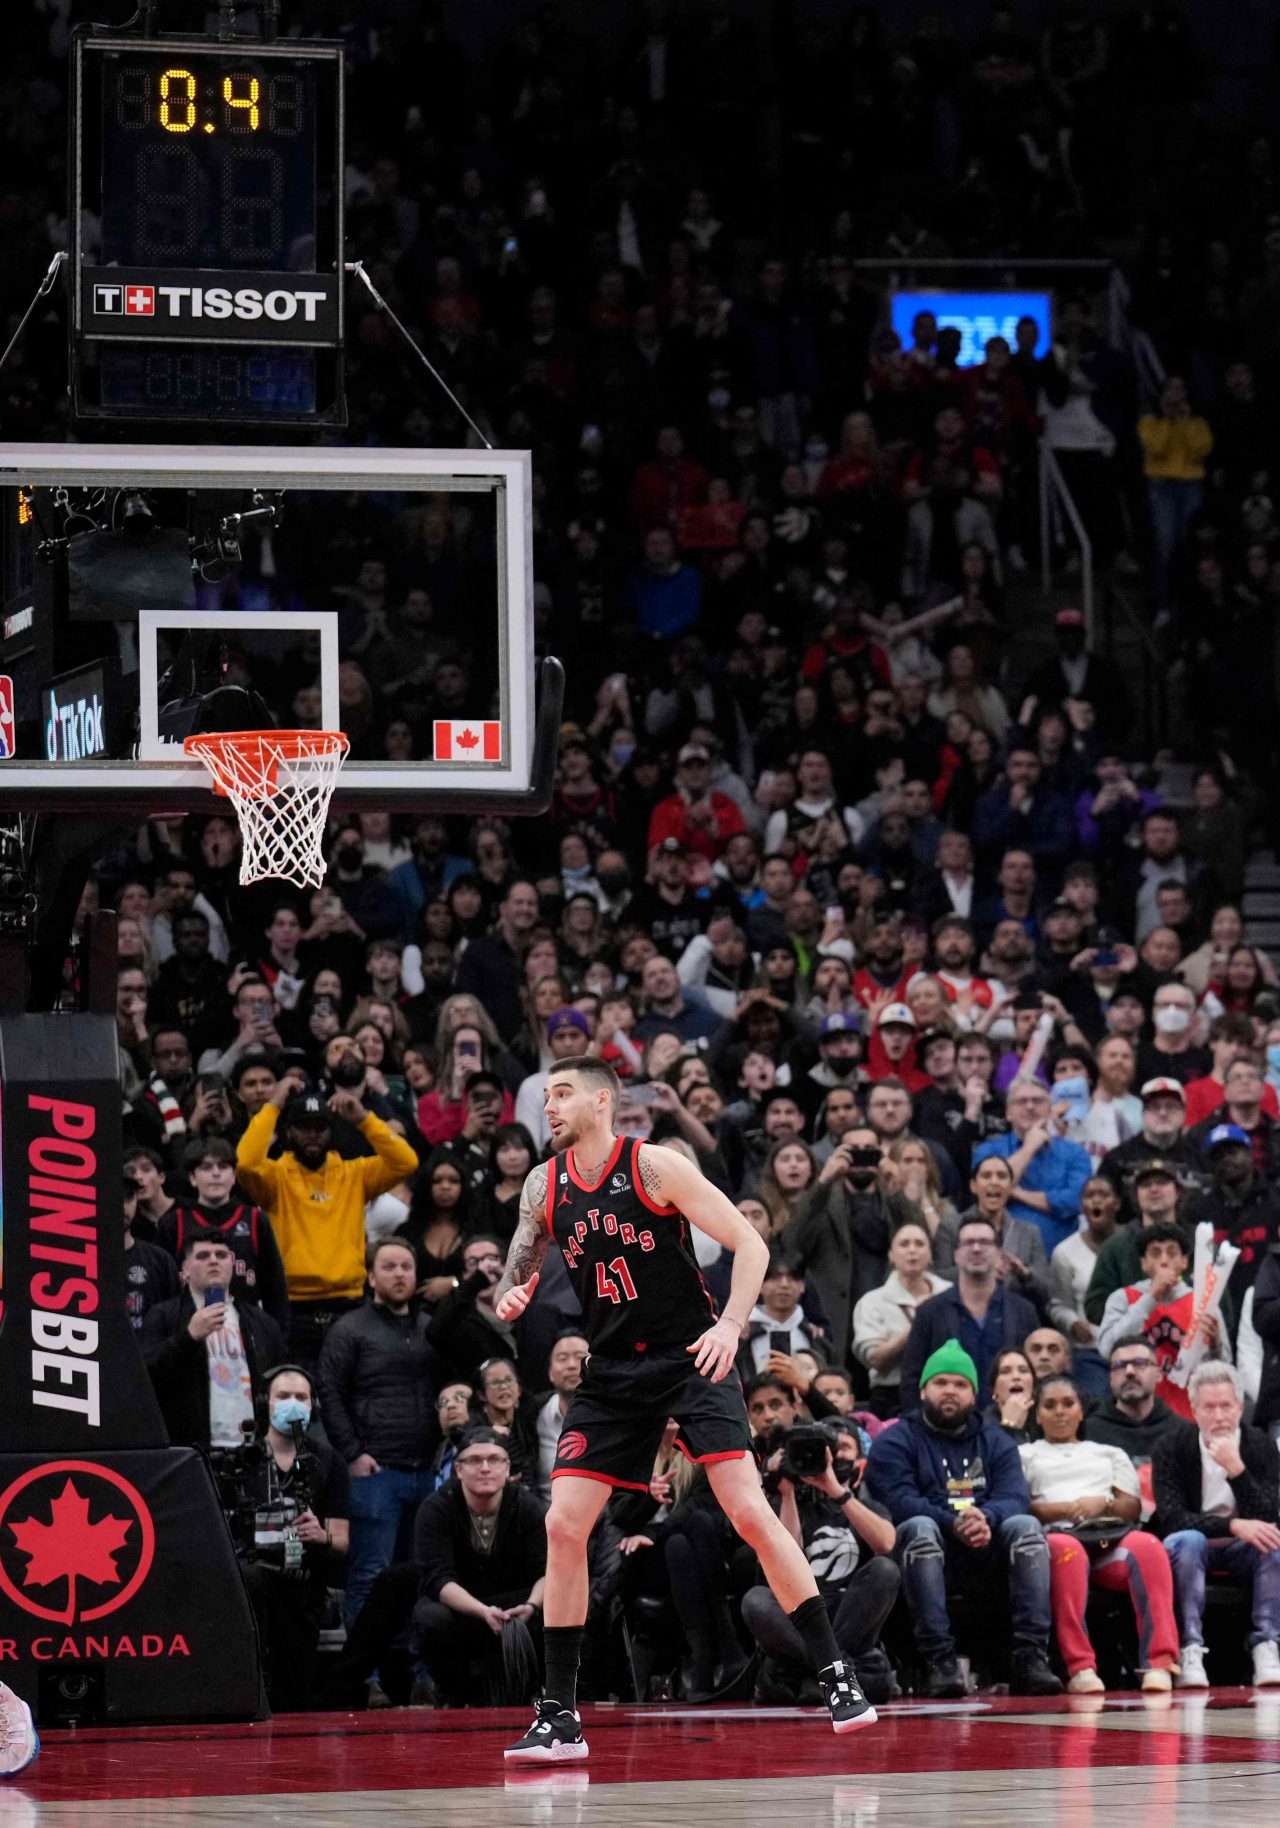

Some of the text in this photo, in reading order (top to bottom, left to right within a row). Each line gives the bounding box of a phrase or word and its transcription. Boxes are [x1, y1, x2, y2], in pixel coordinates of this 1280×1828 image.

[160, 69, 259, 133] 0.4
[158, 286, 327, 322] TISSOT
[59, 694, 104, 761] TikTok
[560, 1173, 568, 1184] 6
[563, 1209, 655, 1268] RAPTORS
[595, 1256, 638, 1304] 41
[31, 1634, 191, 1661] CANADA
